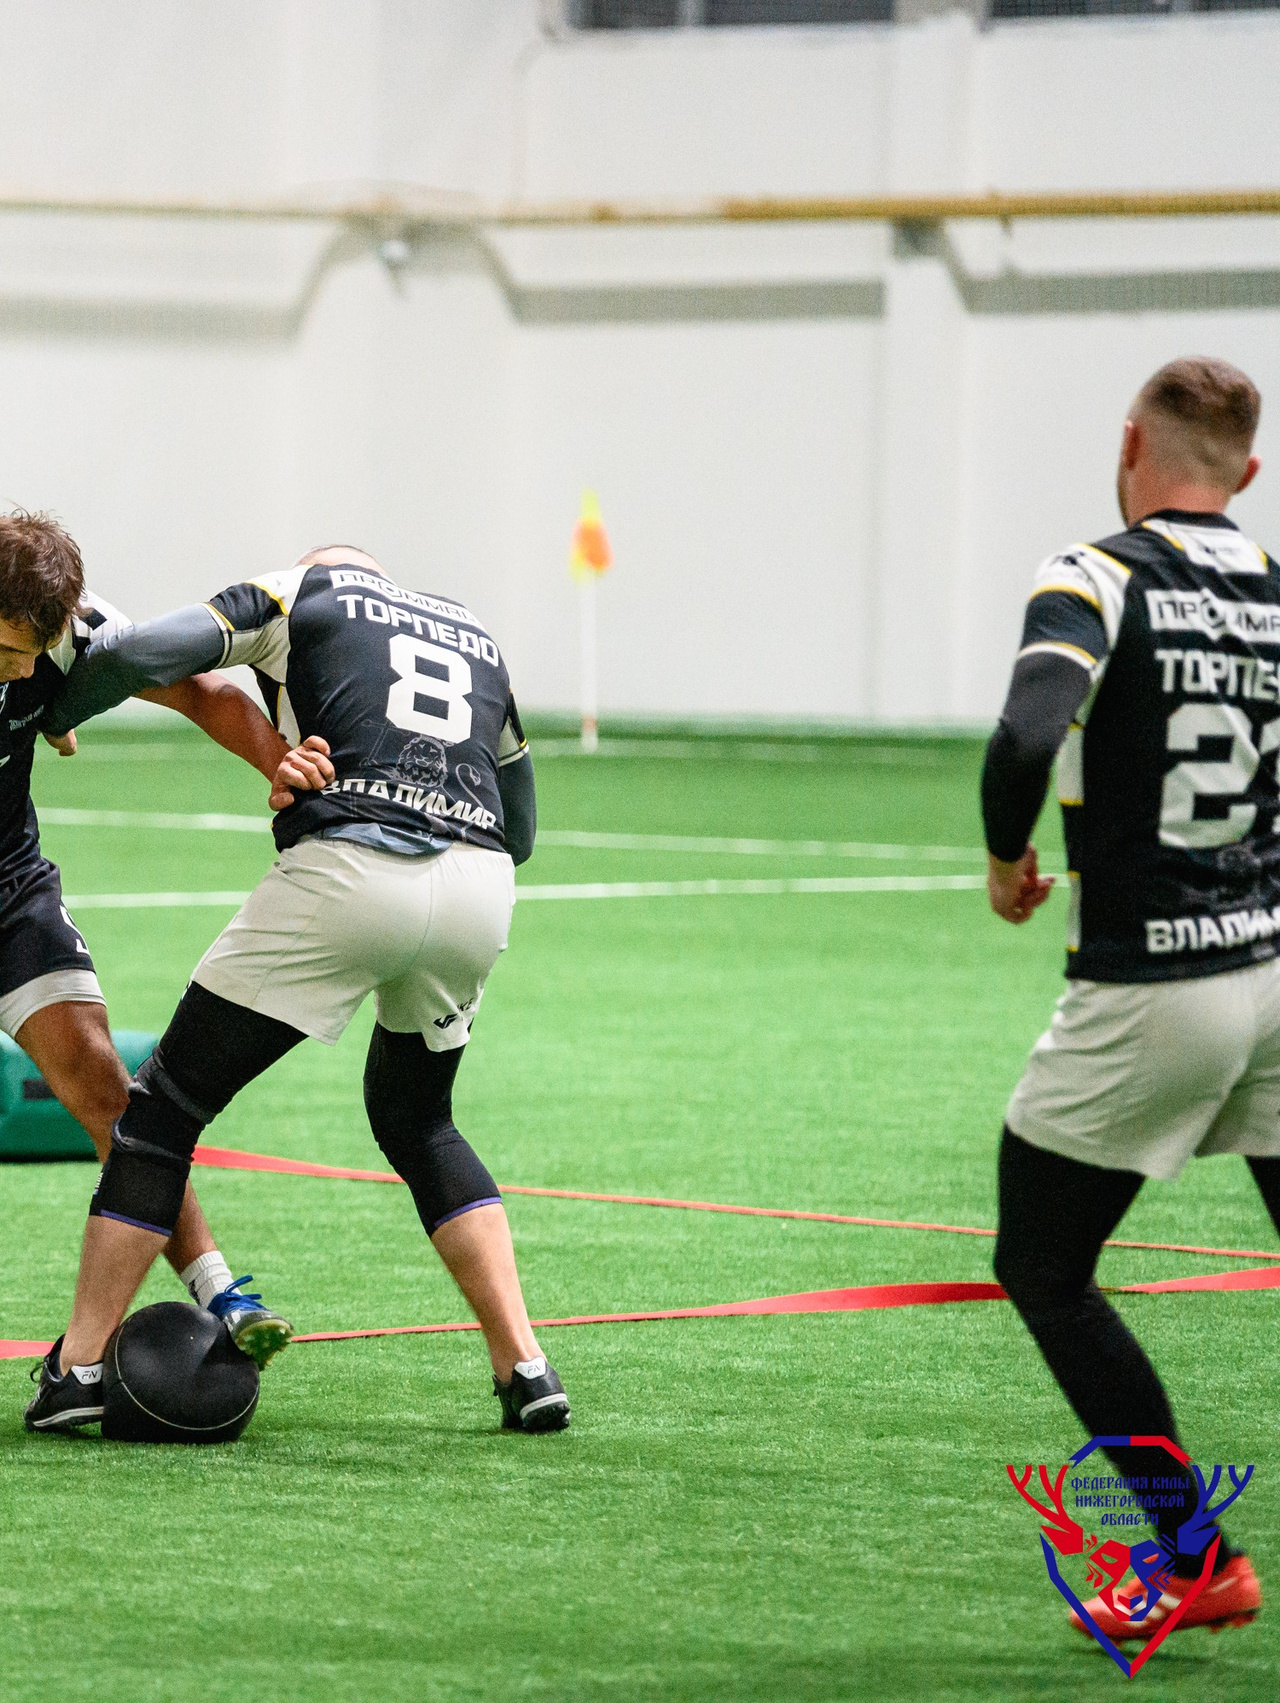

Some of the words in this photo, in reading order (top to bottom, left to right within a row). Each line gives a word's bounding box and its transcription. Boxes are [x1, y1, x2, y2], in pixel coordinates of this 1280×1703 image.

[336, 594, 499, 667] ТОРПЕДО
[386, 633, 473, 745] 8
[1154, 648, 1280, 701] ТОРПЕ
